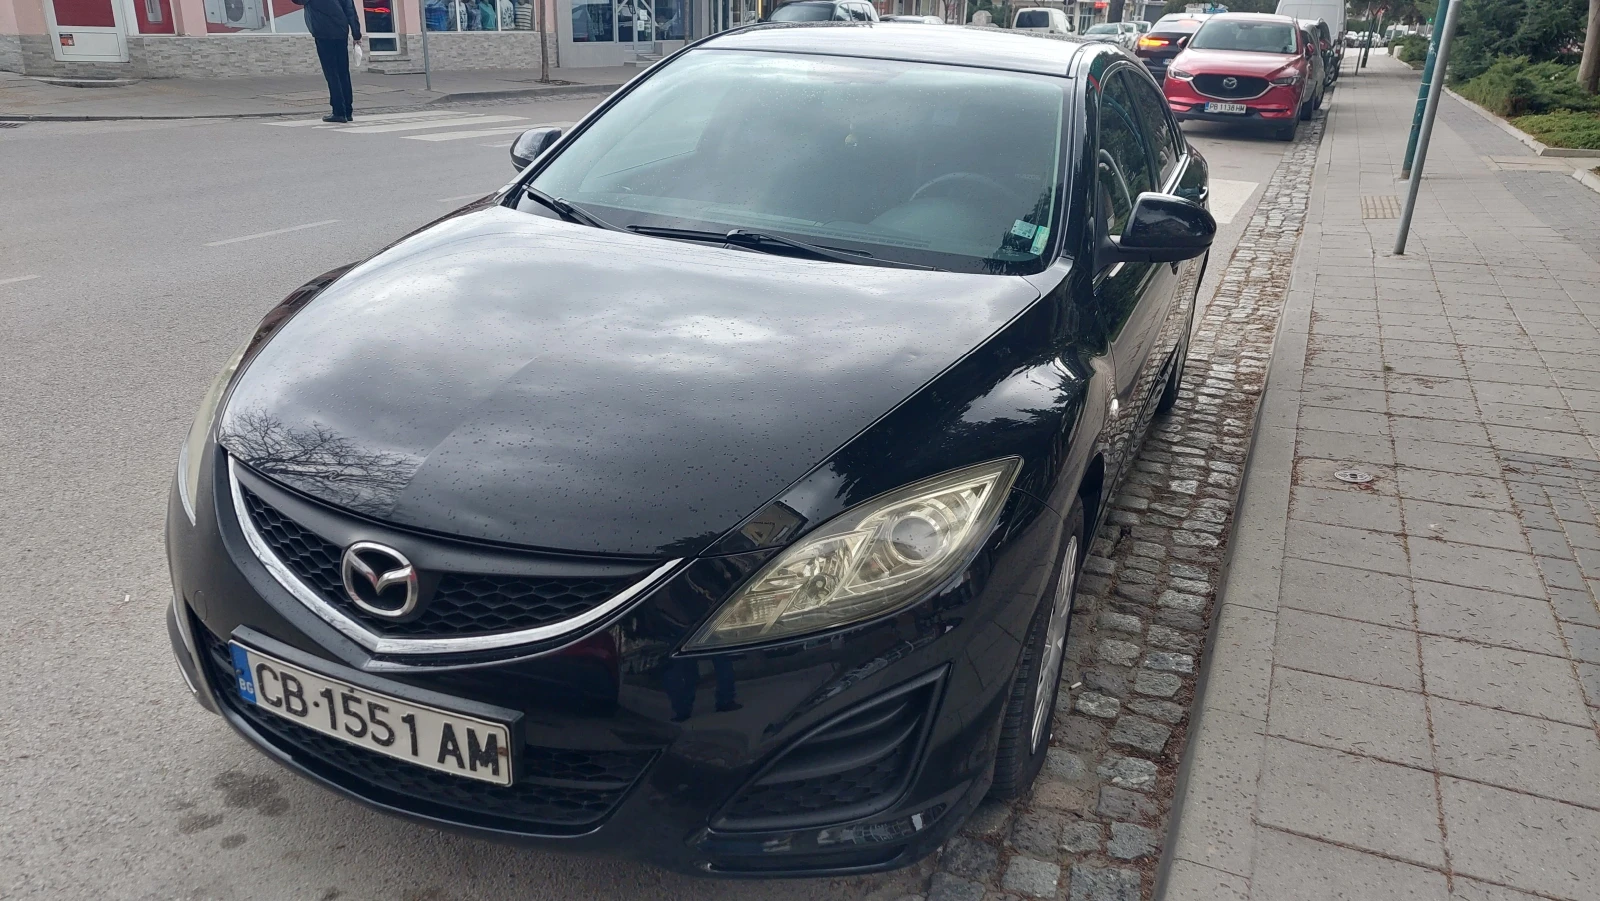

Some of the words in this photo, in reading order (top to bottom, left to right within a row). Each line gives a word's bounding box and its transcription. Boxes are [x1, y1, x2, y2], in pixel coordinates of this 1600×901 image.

[239, 677, 254, 694] BG
[319, 687, 419, 757] 1551
[437, 723, 500, 777] AM
